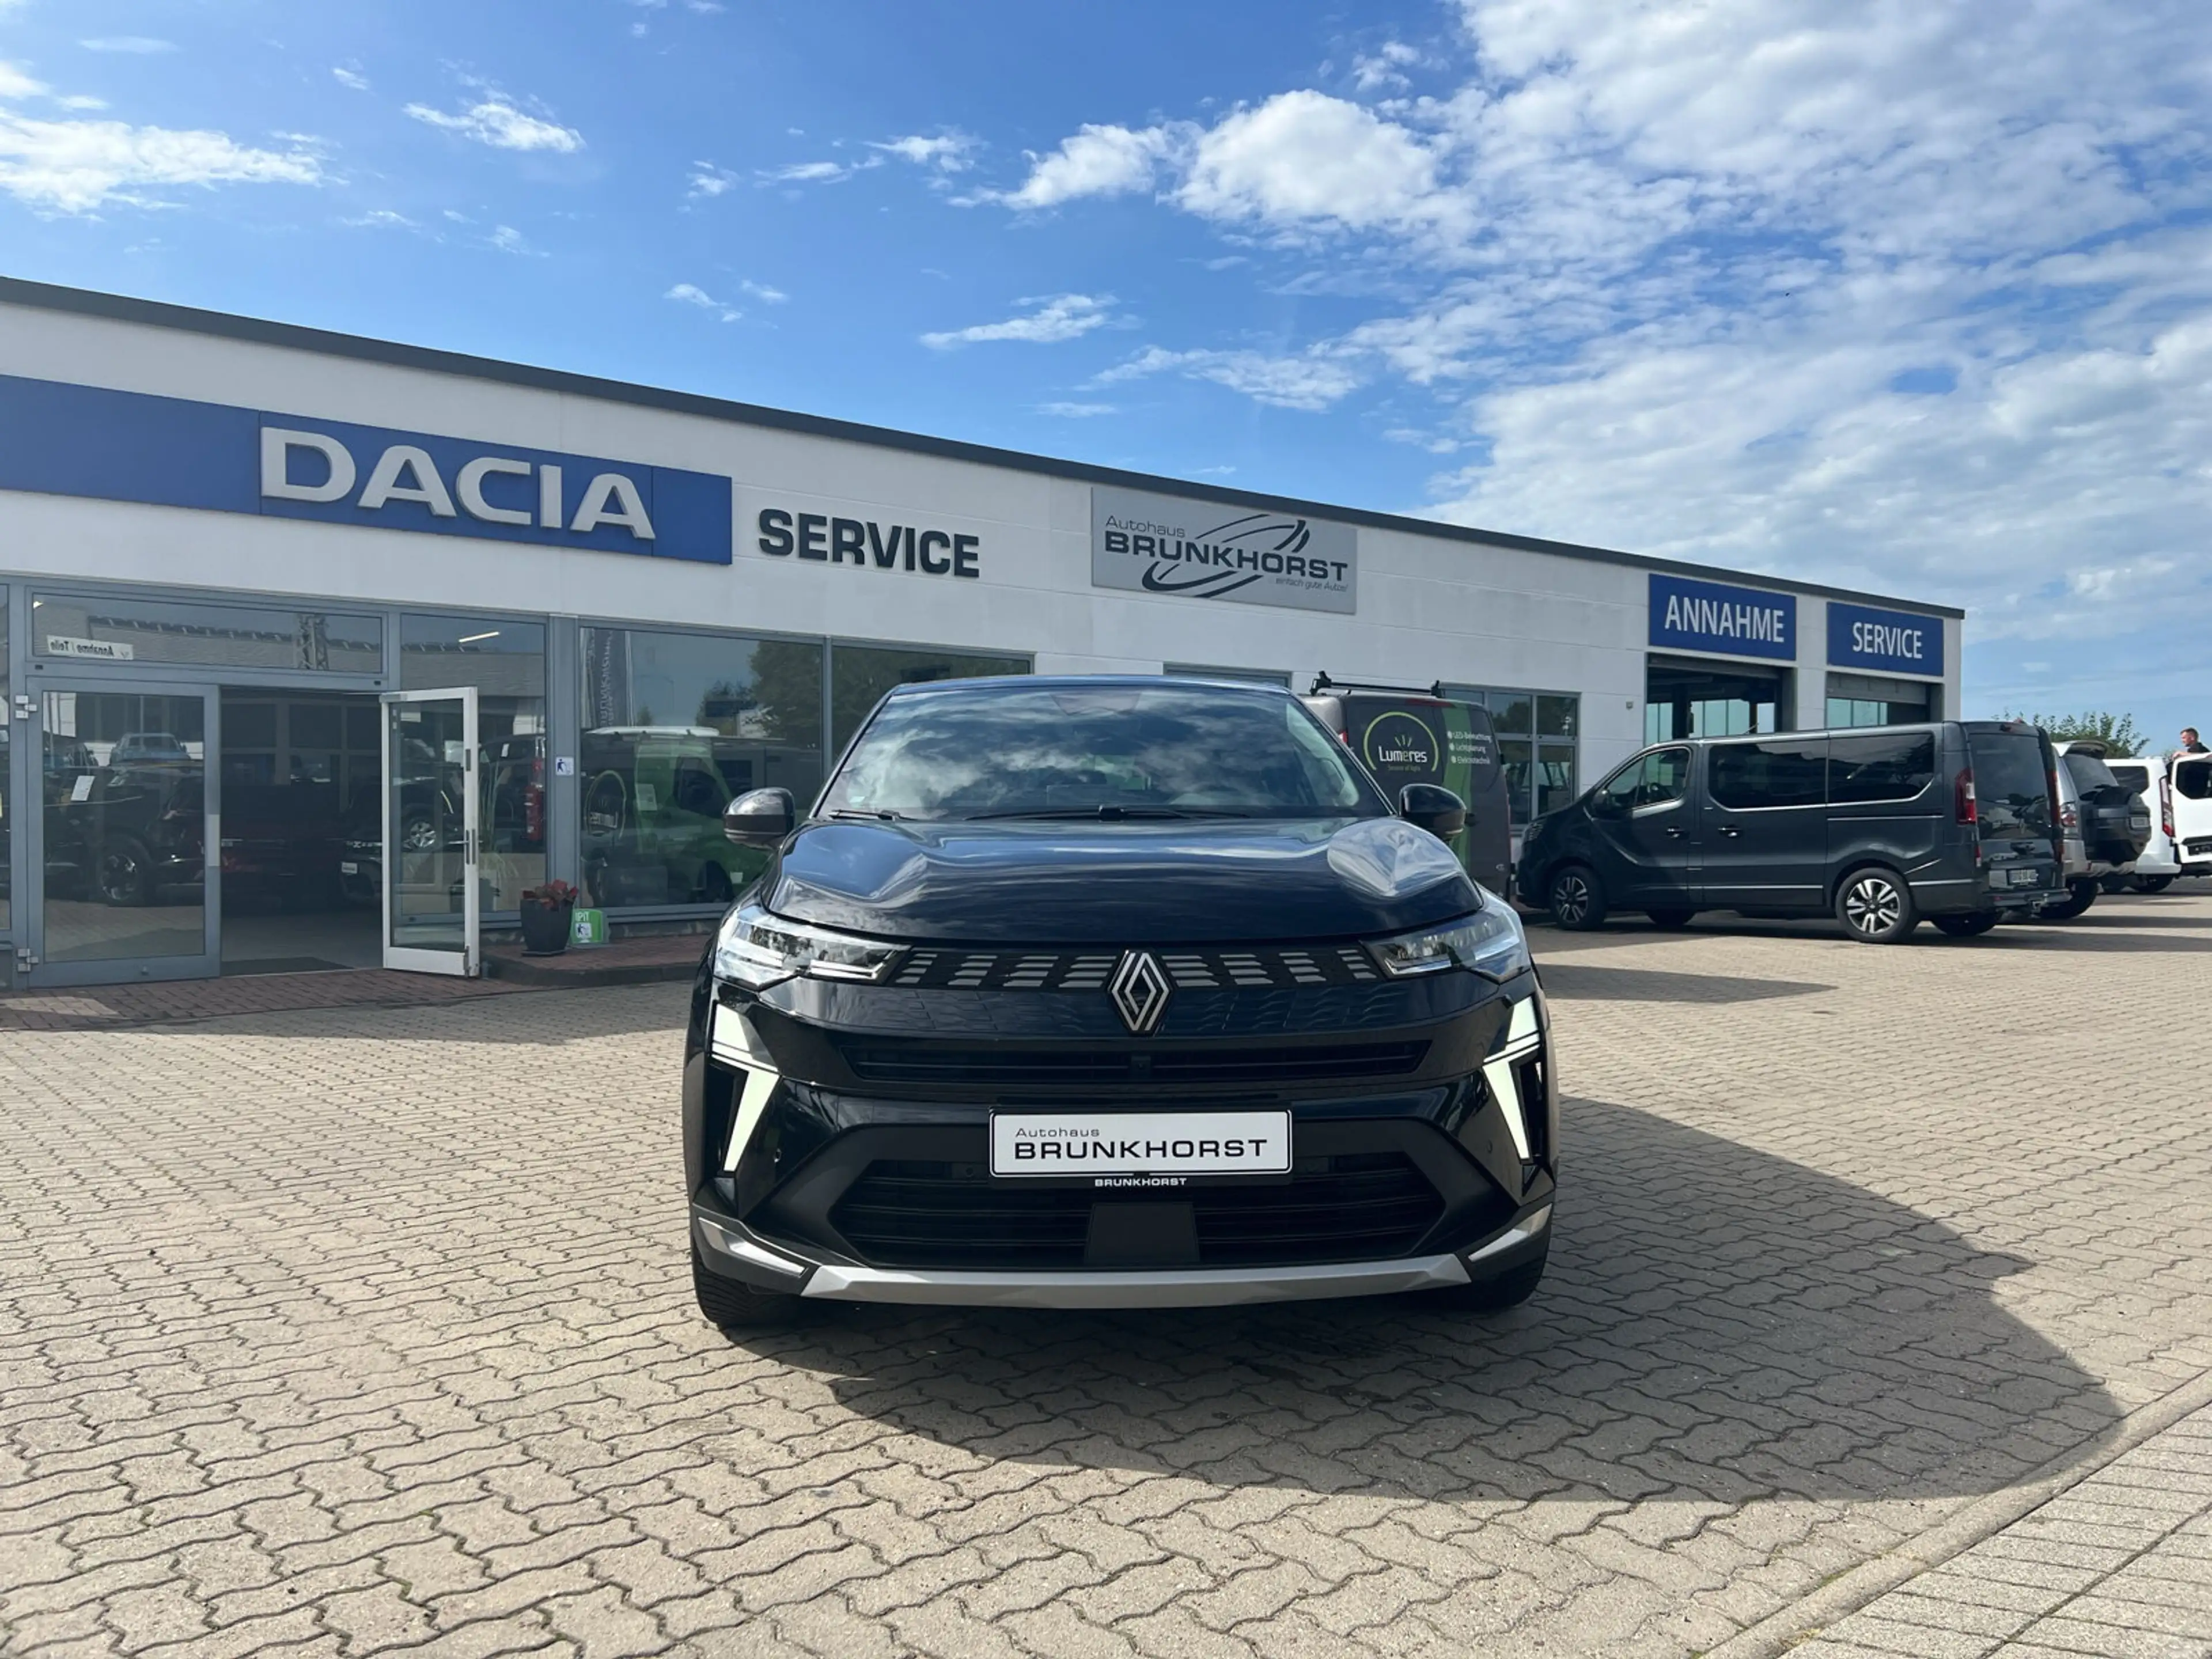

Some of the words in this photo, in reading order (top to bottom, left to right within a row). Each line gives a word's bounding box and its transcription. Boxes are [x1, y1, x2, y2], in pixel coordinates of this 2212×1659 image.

[261, 427, 656, 539] DACIA
[1105, 516, 1185, 537] Autohaus
[759, 509, 979, 578] SERVICE
[1105, 531, 1348, 581] BRUNKHORST
[1665, 595, 1785, 642] ANNAHME
[1852, 622, 1923, 659] SERVICE
[1378, 745, 1428, 763] Lumeres
[1015, 1127, 1100, 1138] Autohaus
[1014, 1139, 1268, 1160] BRUNKHORST
[1094, 1177, 1187, 1187] BRUNKHORST
